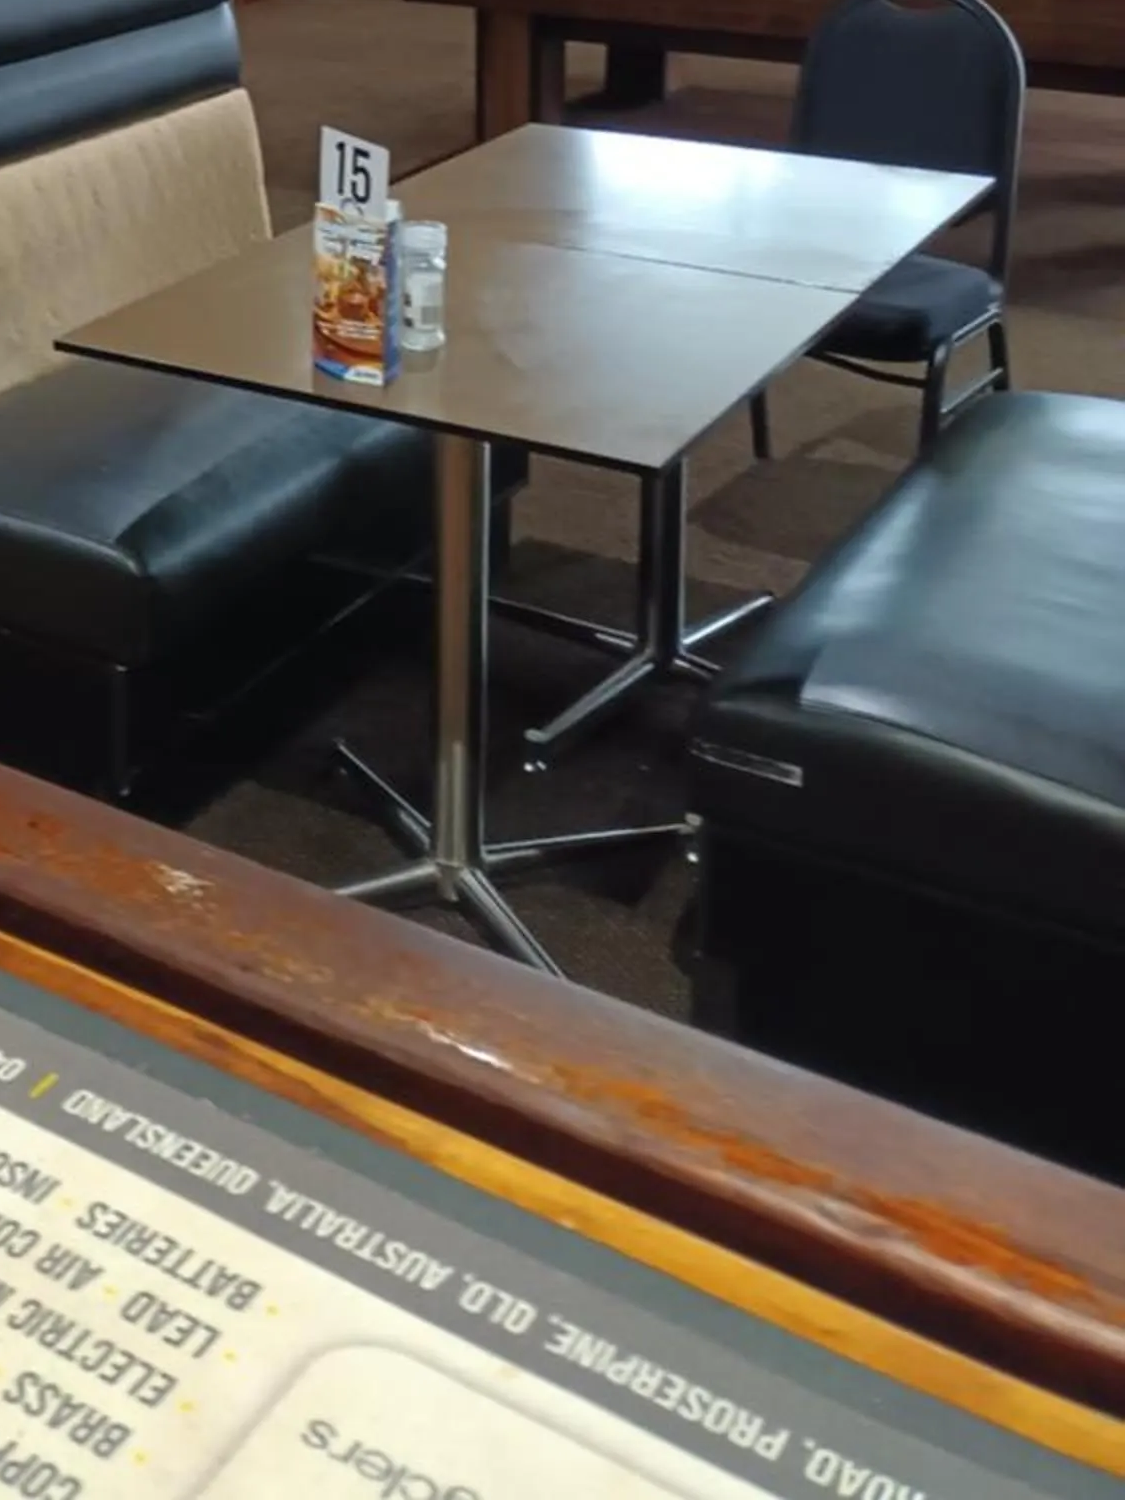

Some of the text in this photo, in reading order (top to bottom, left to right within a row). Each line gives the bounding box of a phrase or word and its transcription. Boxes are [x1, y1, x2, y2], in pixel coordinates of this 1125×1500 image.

[336, 141, 371, 204] 15
[62, 1089, 260, 1195] QUEENSLAND
[34, 1243, 104, 1291] AIR
[75, 1201, 263, 1312] BATTERIES
[6, 1298, 178, 1408] ELECTRIC
[120, 1291, 221, 1359] LEAD
[2, 1371, 132, 1459] BRASS
